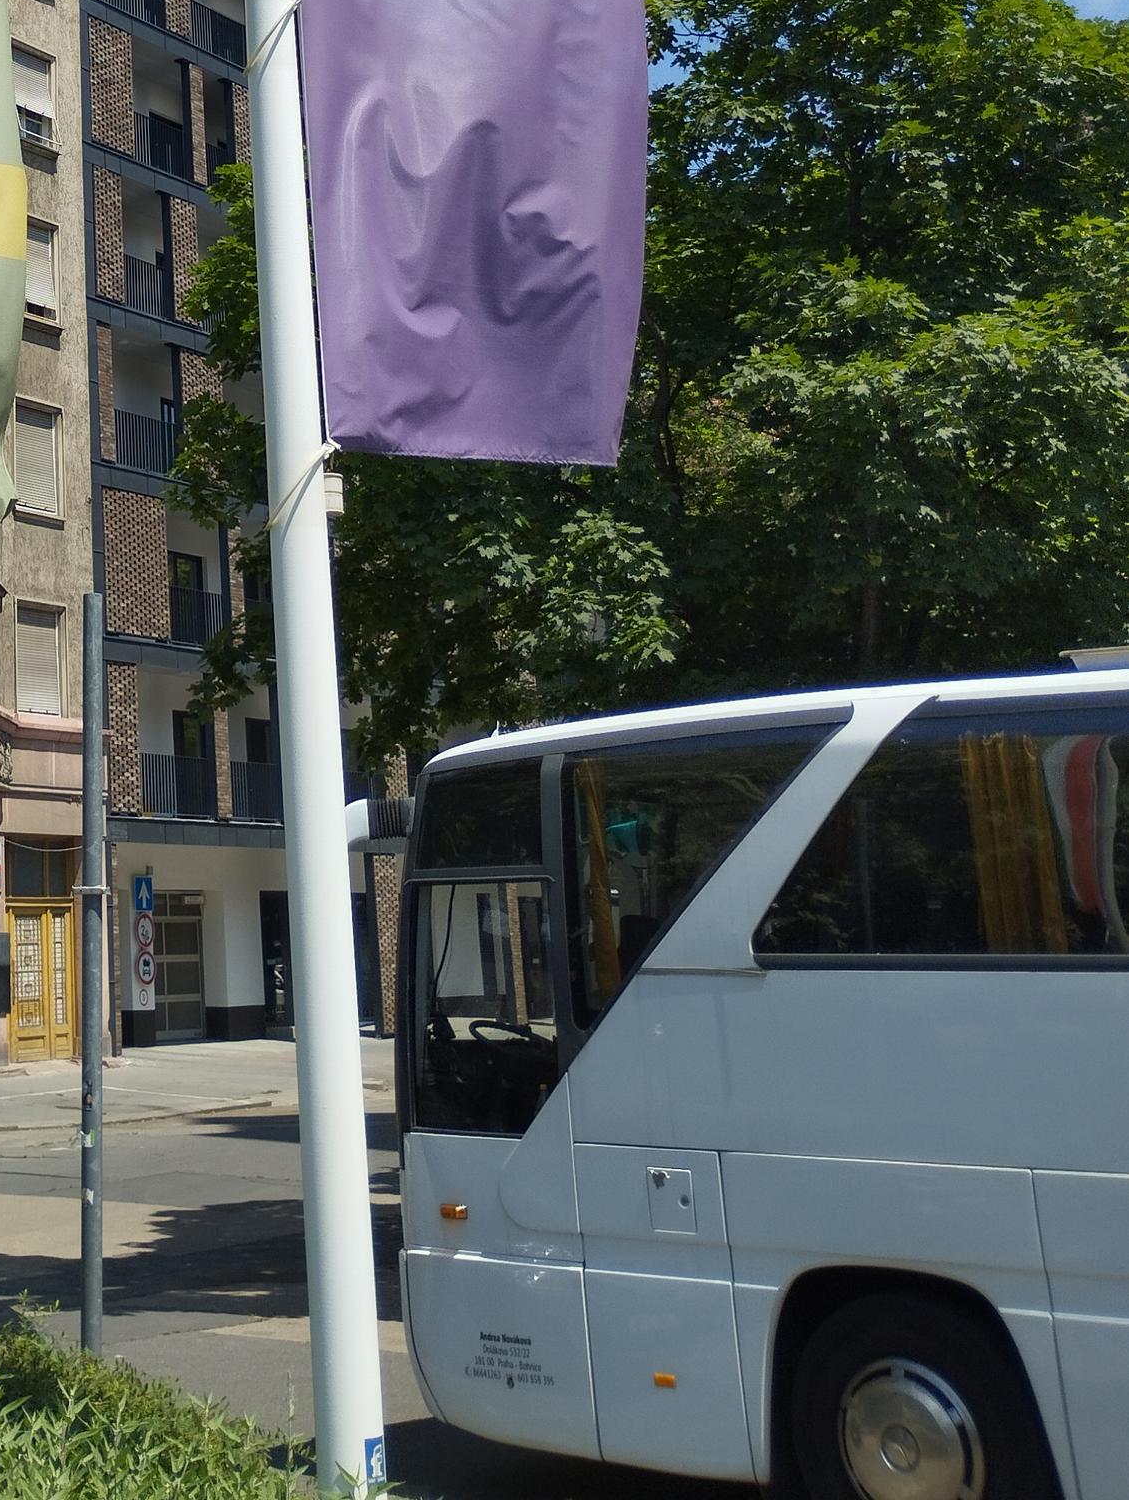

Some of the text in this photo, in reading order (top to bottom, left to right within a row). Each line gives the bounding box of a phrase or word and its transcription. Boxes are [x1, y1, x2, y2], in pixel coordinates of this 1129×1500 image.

[479, 1331, 531, 1345] Andrea Nováková
[487, 1356, 494, 1366] 00
[498, 1358, 514, 1369] Praha
[519, 1360, 542, 1372] Bohnice
